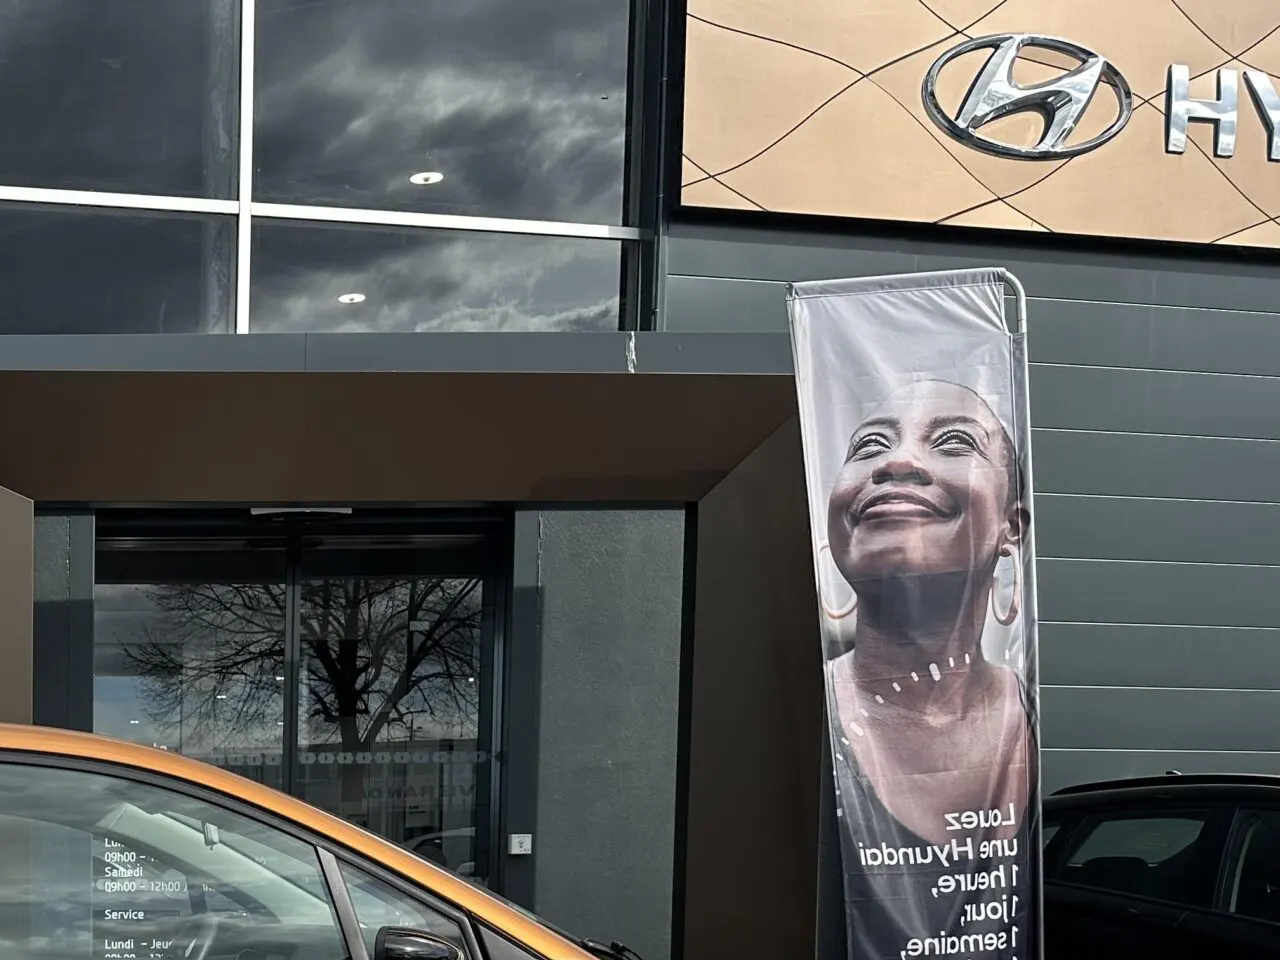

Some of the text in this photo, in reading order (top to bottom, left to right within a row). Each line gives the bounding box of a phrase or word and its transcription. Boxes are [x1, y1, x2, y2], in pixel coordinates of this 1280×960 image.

[104, 852, 136, 862] 09h00
[104, 881, 136, 892] 09h00
[150, 881, 181, 892] 12h00
[104, 909, 145, 920] Service
[104, 939, 134, 949] Lundi
[150, 939, 175, 949] Jeu
